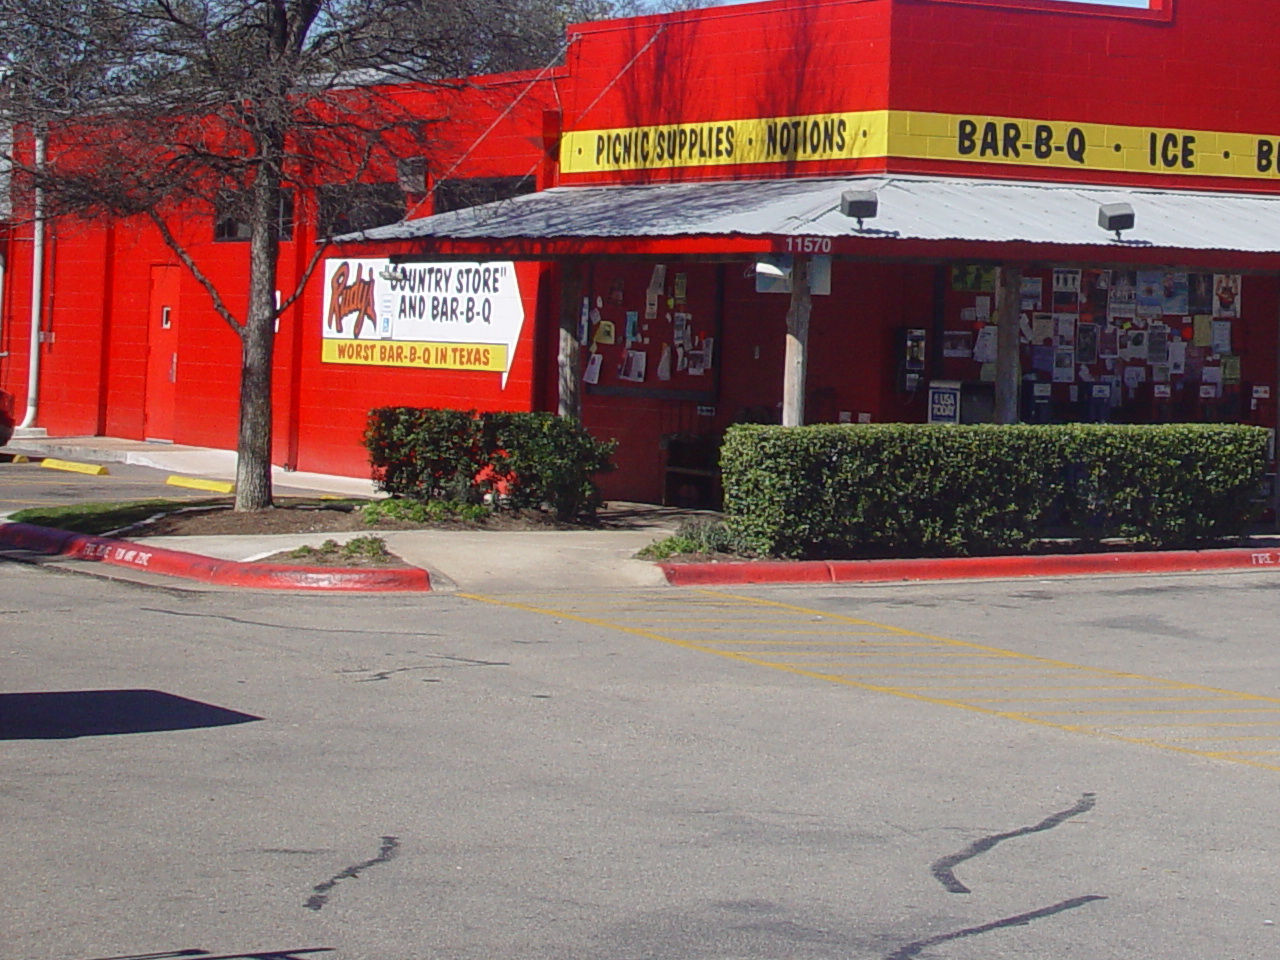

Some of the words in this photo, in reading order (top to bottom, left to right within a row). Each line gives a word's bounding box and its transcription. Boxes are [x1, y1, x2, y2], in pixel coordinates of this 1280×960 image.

[596, 130, 650, 166] PICNIC
[655, 124, 735, 162] SUPPLIES
[765, 117, 848, 157] NOTIONS
[957, 119, 1087, 165] BAR-B-Q
[1149, 131, 1197, 169] ICE
[785, 237, 832, 253] 11570
[327, 260, 377, 339] Rudy's
[398, 294, 426, 320] AND
[431, 296, 493, 325] BAR-B-Q
[337, 344, 376, 366] WORST
[379, 345, 431, 365] BAR-B-Q
[434, 347, 448, 365] IN
[451, 348, 491, 366] TEXAS
